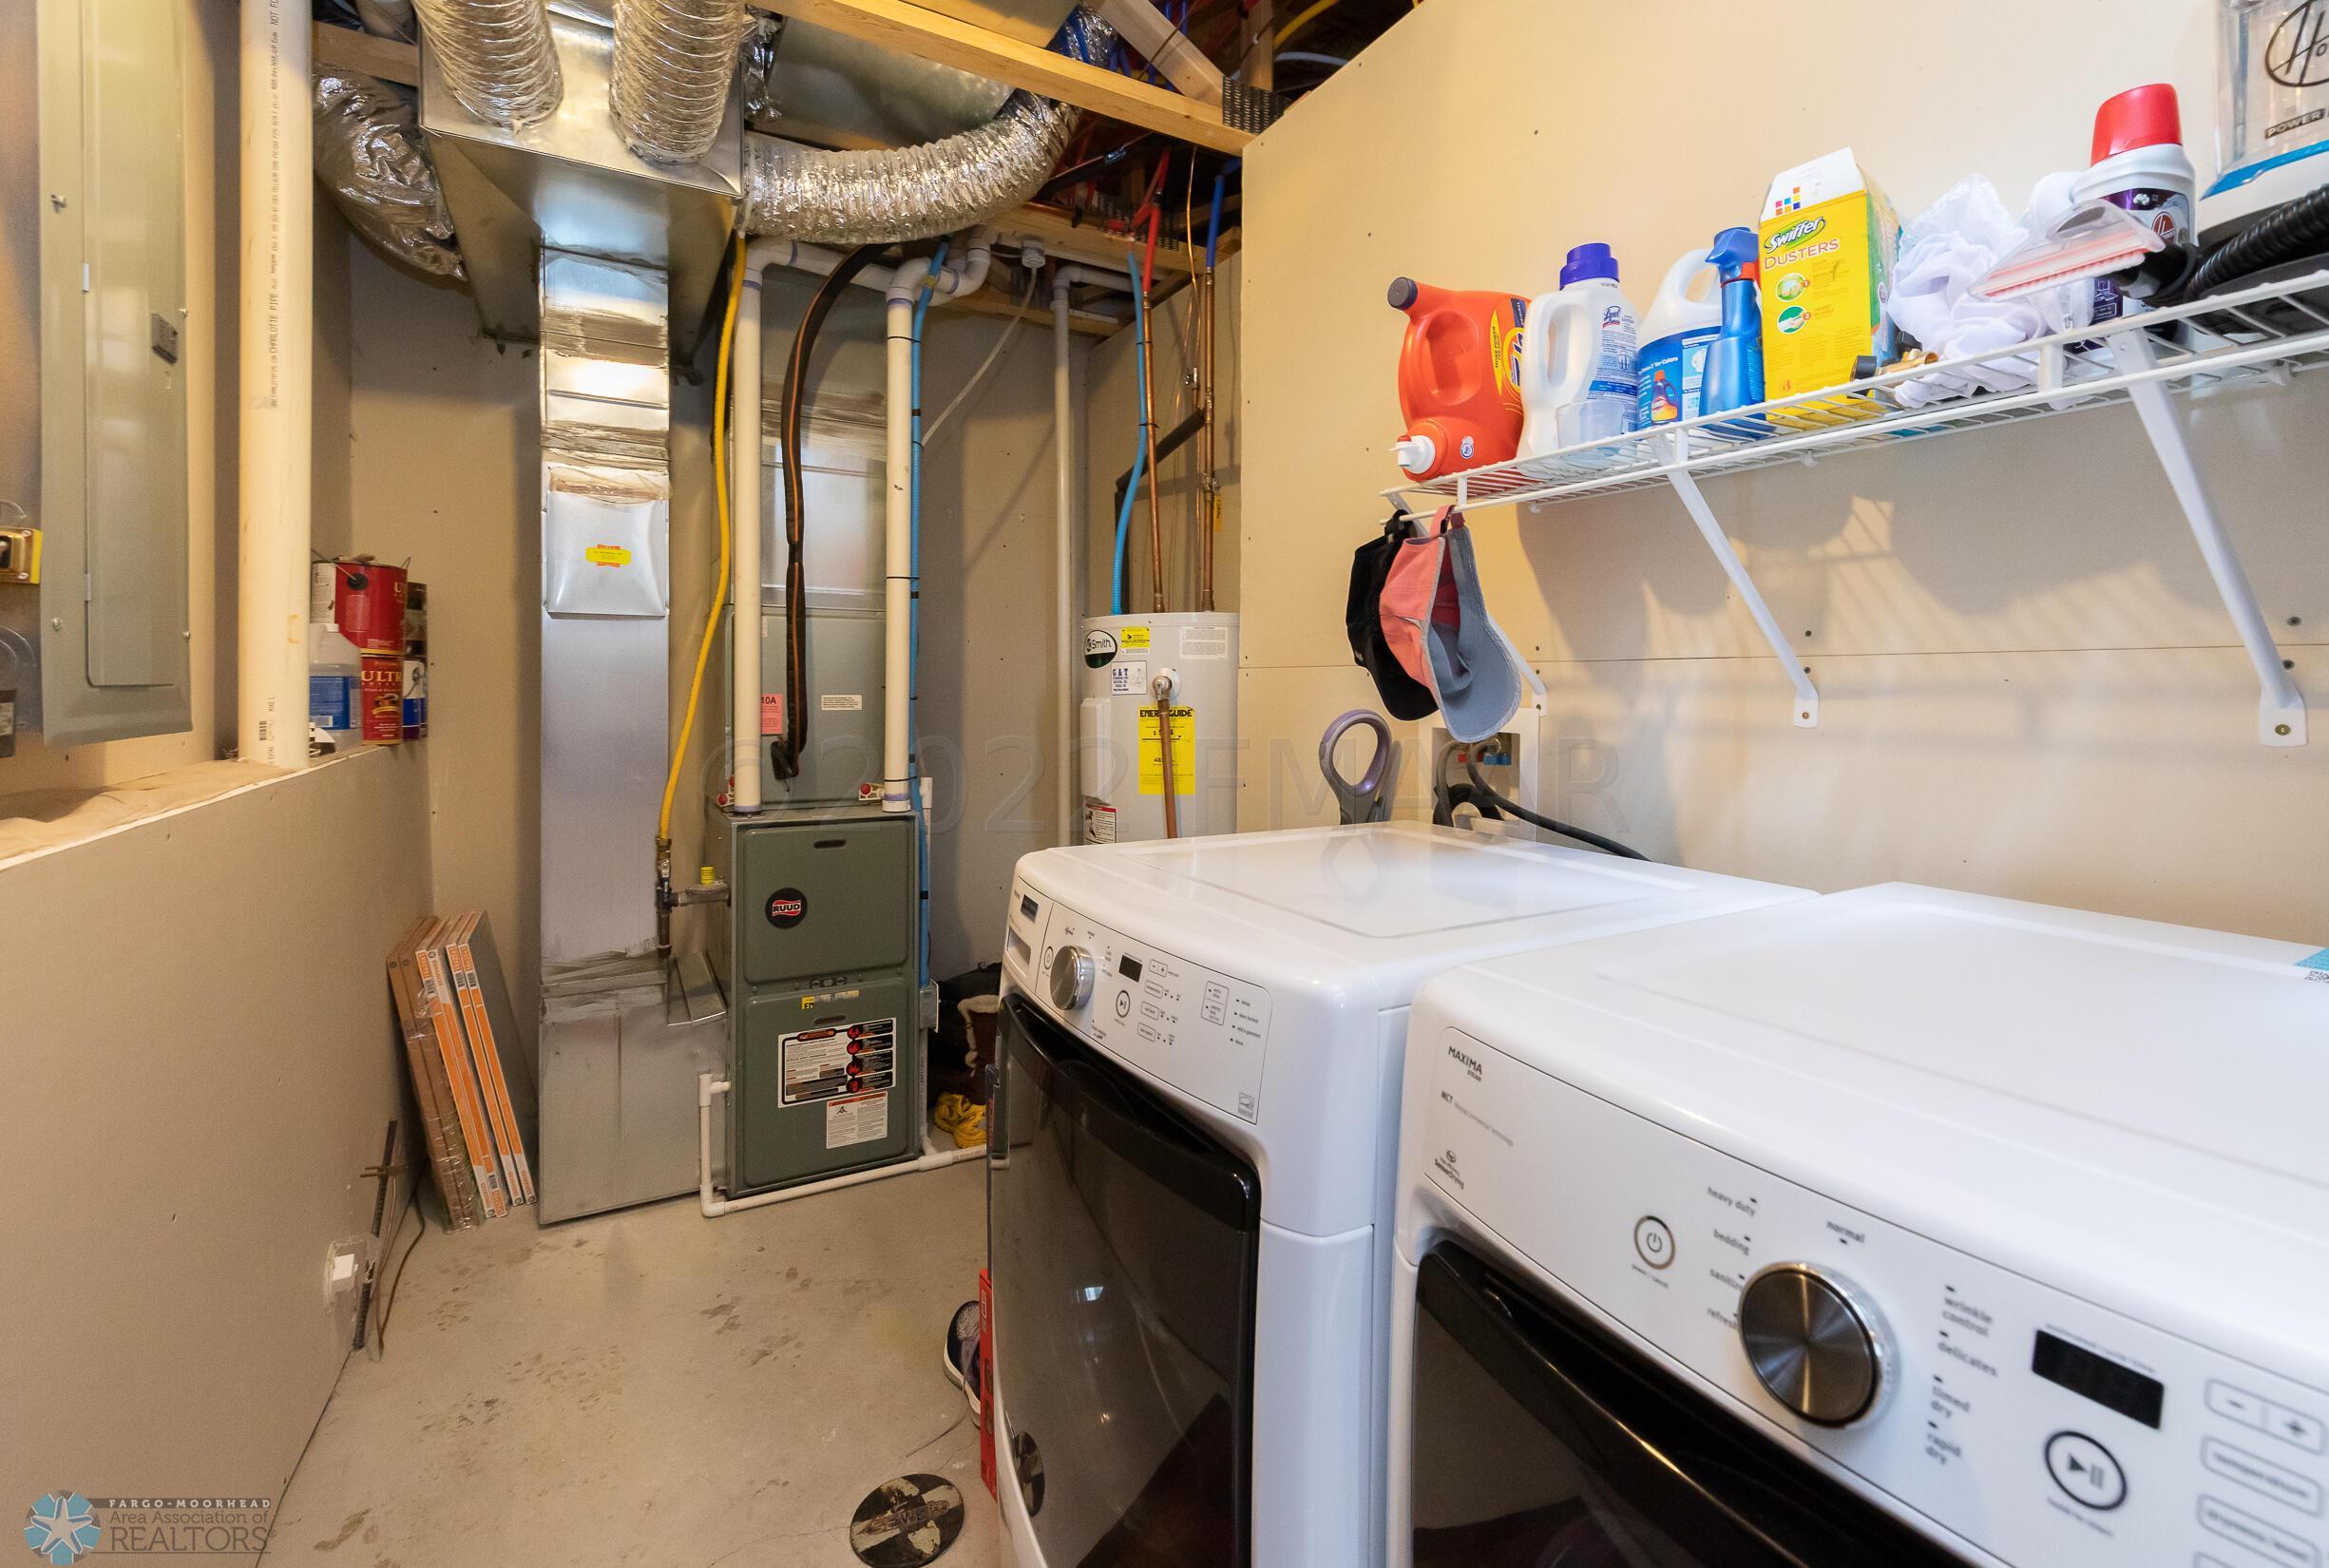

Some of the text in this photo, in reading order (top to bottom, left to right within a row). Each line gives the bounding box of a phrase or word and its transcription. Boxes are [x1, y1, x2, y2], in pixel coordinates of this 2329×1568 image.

[2267, 110, 2322, 138] POWER
[1765, 218, 1824, 254] Swiffer
[1764, 239, 1840, 271] DUSTERS
[269, 293, 278, 311] PIPE
[1092, 638, 1111, 650] Smith
[773, 904, 800, 913] RUUD
[1447, 1044, 1482, 1075] MAXIMA
[1707, 1186, 1756, 1217] heavy duty
[1712, 1228, 1750, 1256] bedding
[1825, 1220, 1865, 1244] normal
[1941, 1310, 1990, 1338] control
[1943, 1295, 1993, 1325] wrinkle
[1937, 1341, 1998, 1378] delicates
[1930, 1398, 1953, 1419] dry
[1932, 1385, 1971, 1413] timed
[1924, 1445, 1947, 1465] dry
[1927, 1431, 1961, 1458] rapid
